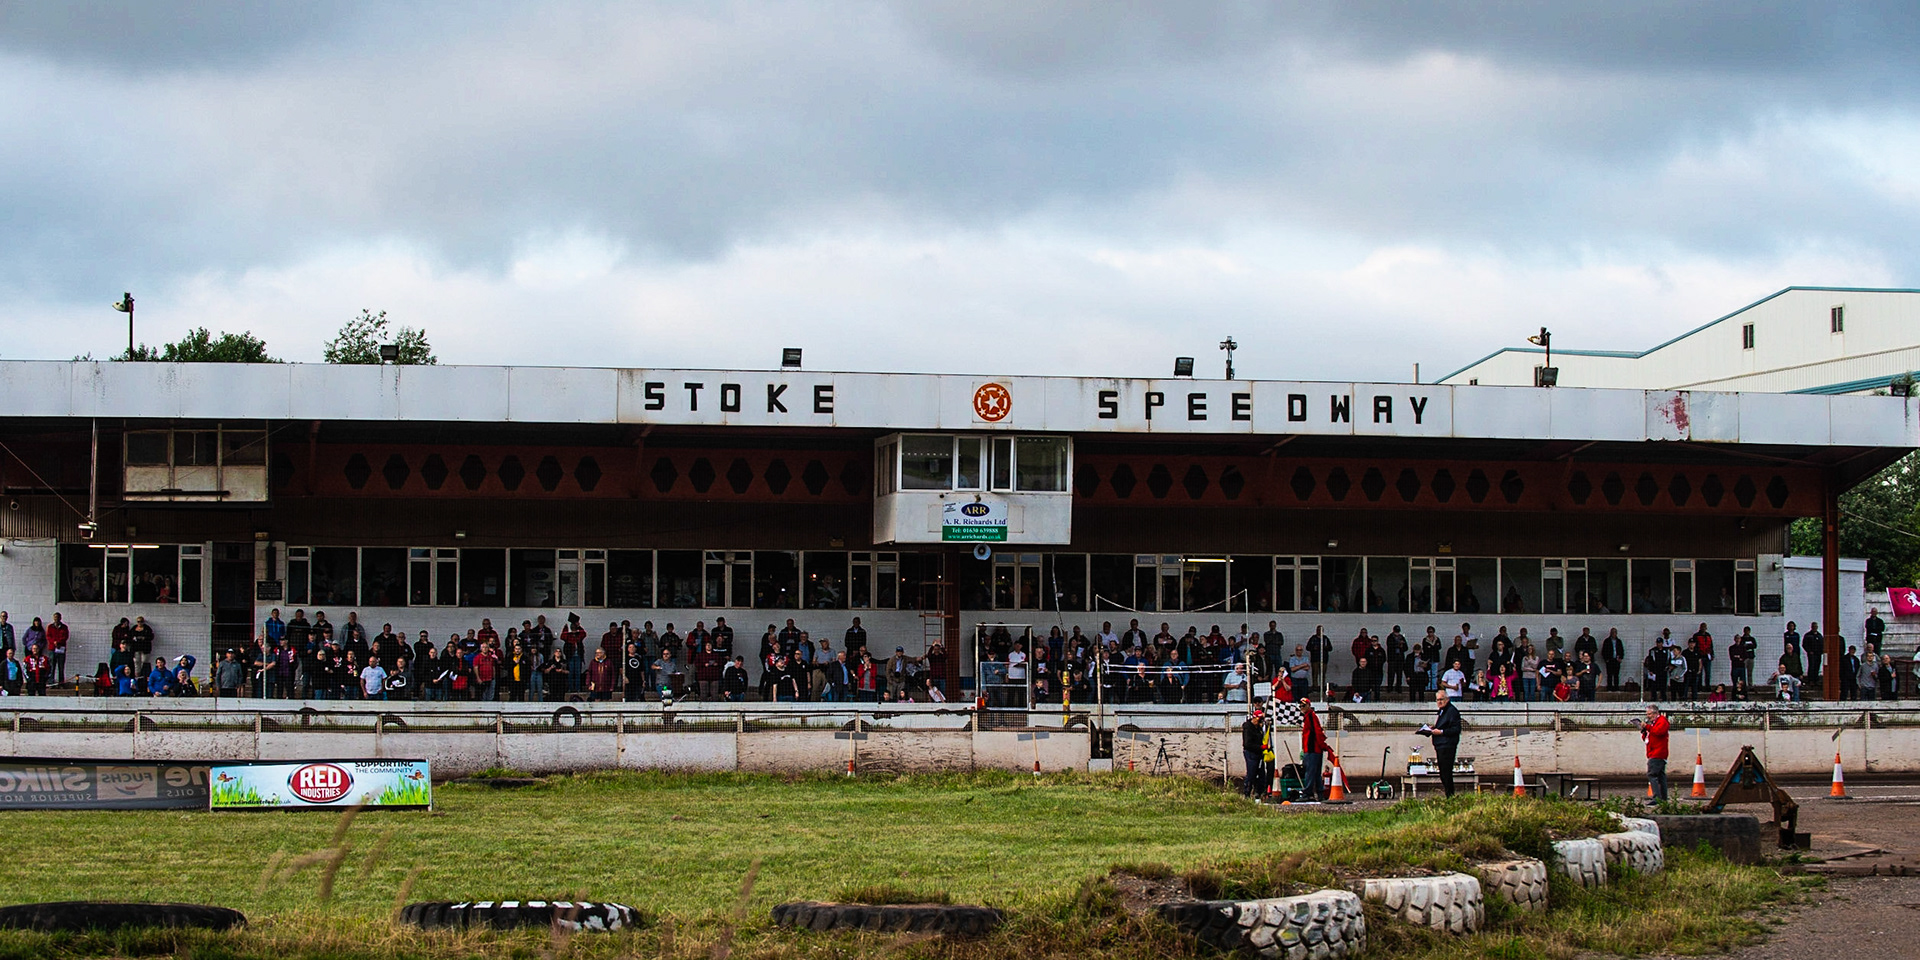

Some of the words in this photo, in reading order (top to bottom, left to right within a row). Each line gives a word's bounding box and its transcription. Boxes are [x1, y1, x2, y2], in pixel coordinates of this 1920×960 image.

[644, 382, 834, 413] STOKE
[1098, 390, 1428, 424] SPEEDWAY
[965, 506, 987, 515] ARR
[300, 766, 342, 788] RED
[300, 786, 341, 799] INDUSTRIES
